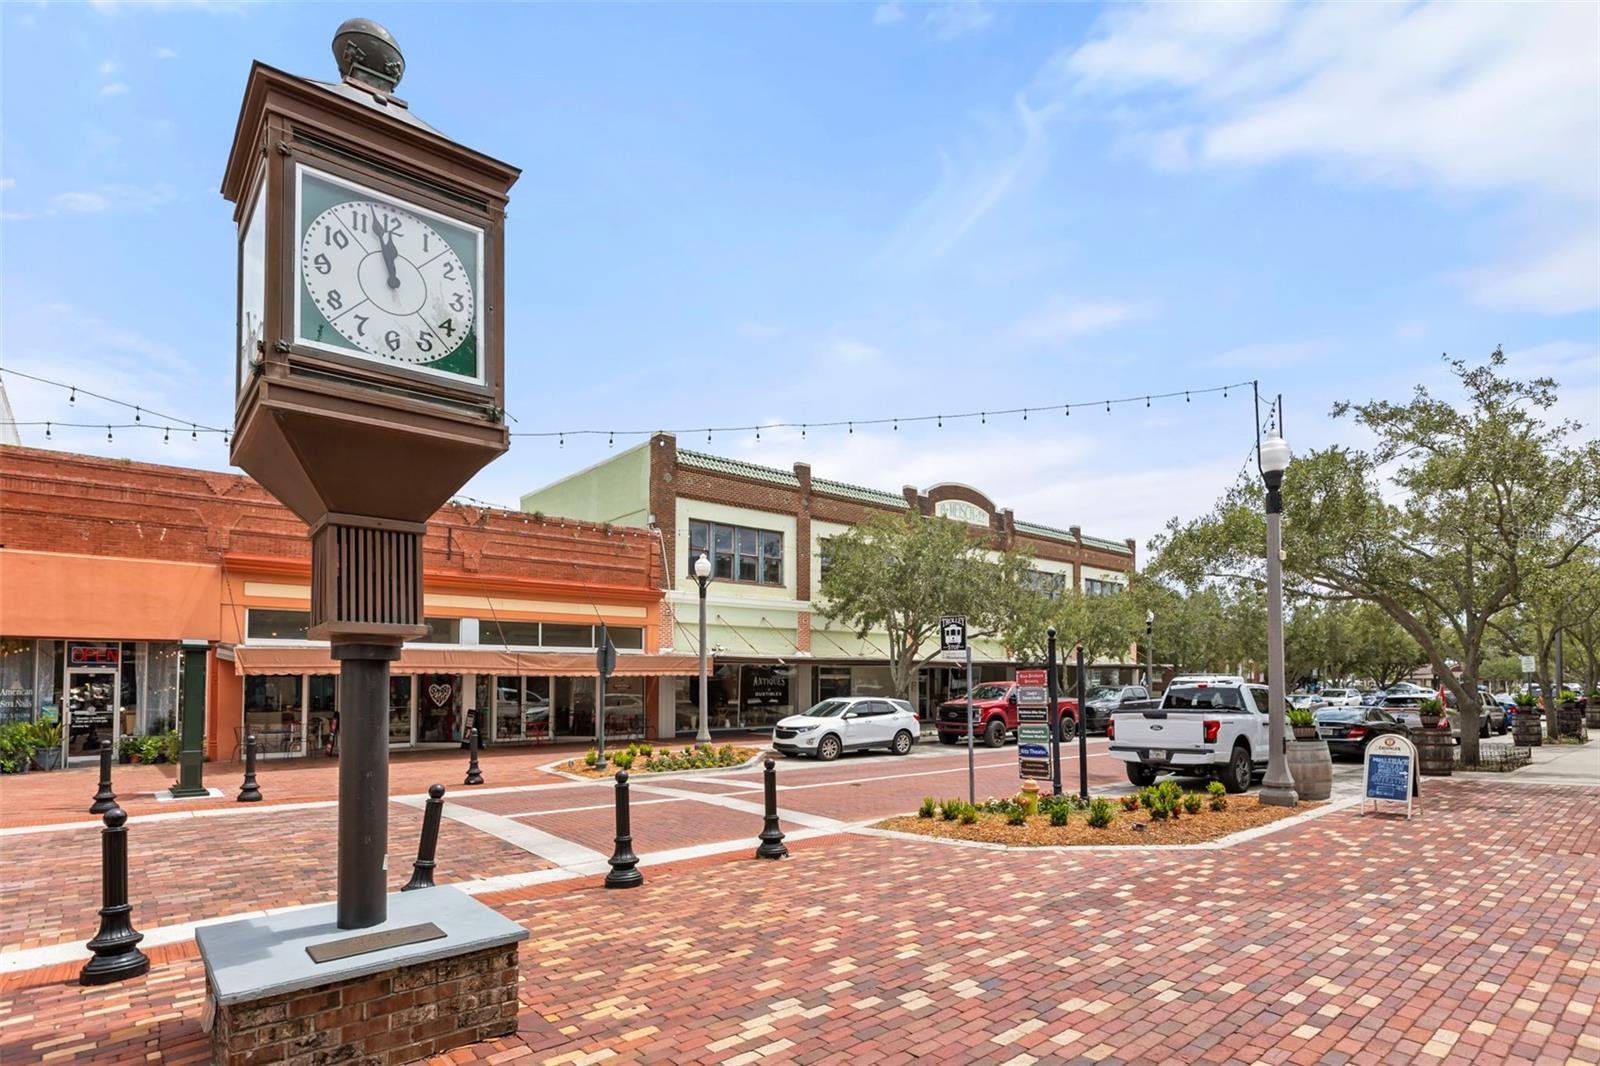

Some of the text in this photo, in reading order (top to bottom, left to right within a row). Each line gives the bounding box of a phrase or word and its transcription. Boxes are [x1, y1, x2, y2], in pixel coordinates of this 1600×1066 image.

[351, 210, 368, 234] 11
[383, 213, 404, 237] 12
[324, 225, 349, 250] 10
[423, 233, 429, 253] 1
[313, 253, 332, 275] 9
[442, 262, 457, 281] 2
[326, 289, 343, 311] 8
[449, 292, 465, 313] 3
[353, 314, 370, 337] 7
[438, 317, 456, 338] 4
[384, 330, 401, 352] 6
[416, 330, 434, 352] 5
[73, 648, 118, 663] OPEN
[753, 676, 785, 687] ANTIQUES
